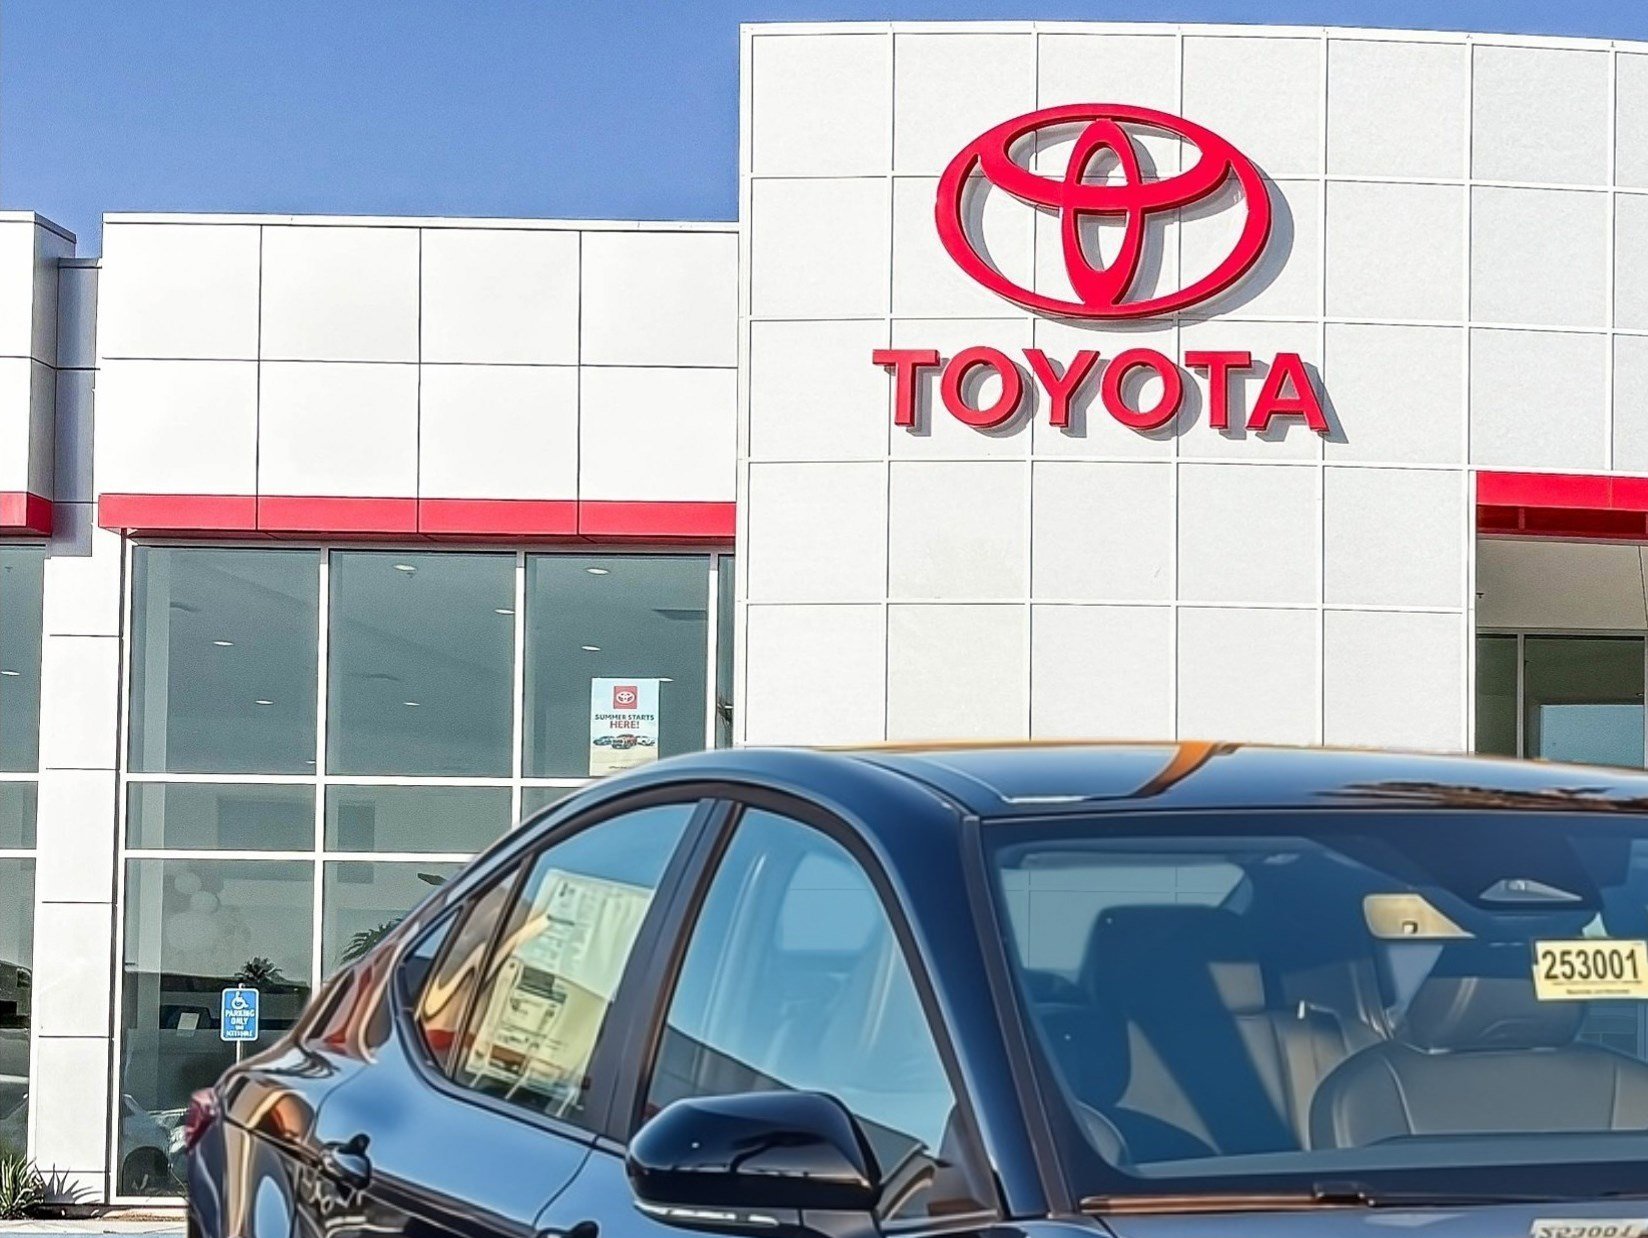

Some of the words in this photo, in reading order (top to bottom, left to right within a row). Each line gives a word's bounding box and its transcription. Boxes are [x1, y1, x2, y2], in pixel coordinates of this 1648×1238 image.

[873, 346, 1328, 432] TOYOTA
[610, 720, 639, 728] HERE!
[1542, 948, 1639, 980] 253001
[225, 1009, 255, 1017] PARKING
[230, 1017, 249, 1025] ONLY
